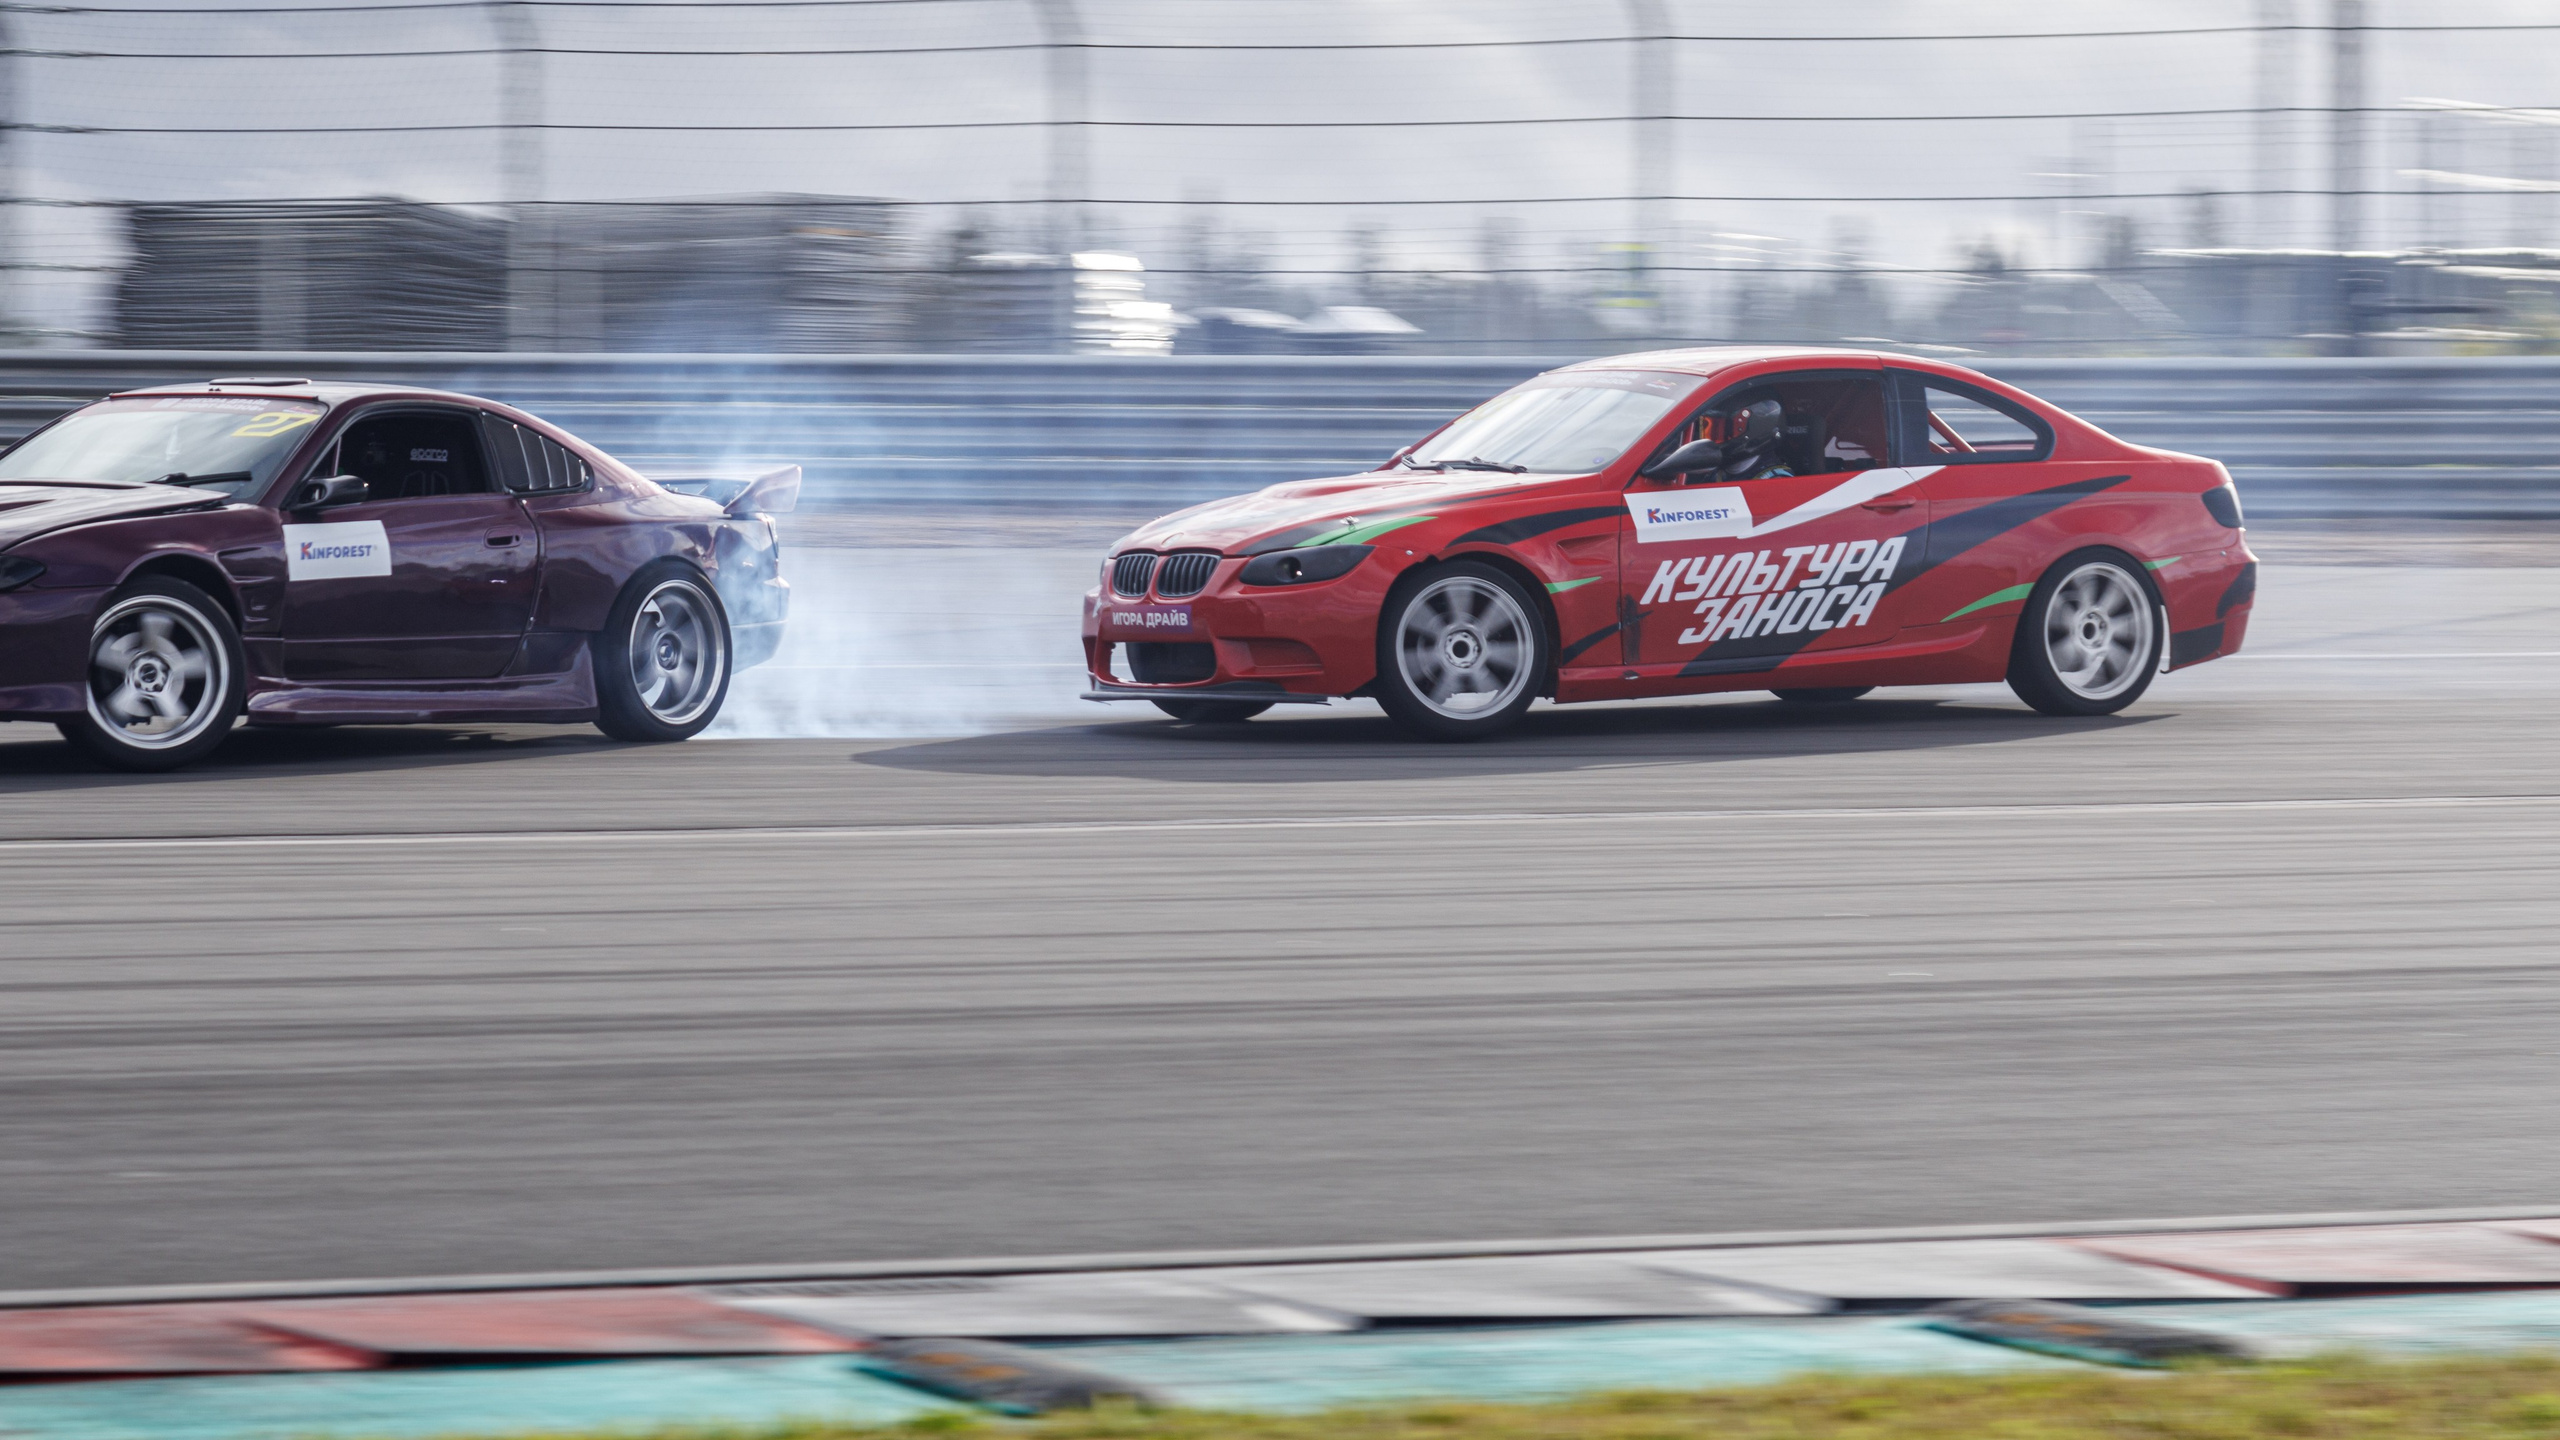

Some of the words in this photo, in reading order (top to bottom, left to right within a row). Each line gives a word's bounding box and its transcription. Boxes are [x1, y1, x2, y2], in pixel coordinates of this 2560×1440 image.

[231, 412, 321, 437] 27
[1647, 508, 1729, 524] KINFOREST
[301, 542, 372, 560] KINFOREST
[1639, 536, 1907, 605] КУЛЬТУРА
[1112, 611, 1145, 626] ИГОРА
[1146, 609, 1189, 629] ДРАЙВ
[1678, 582, 1887, 644] ЗАНОСА
